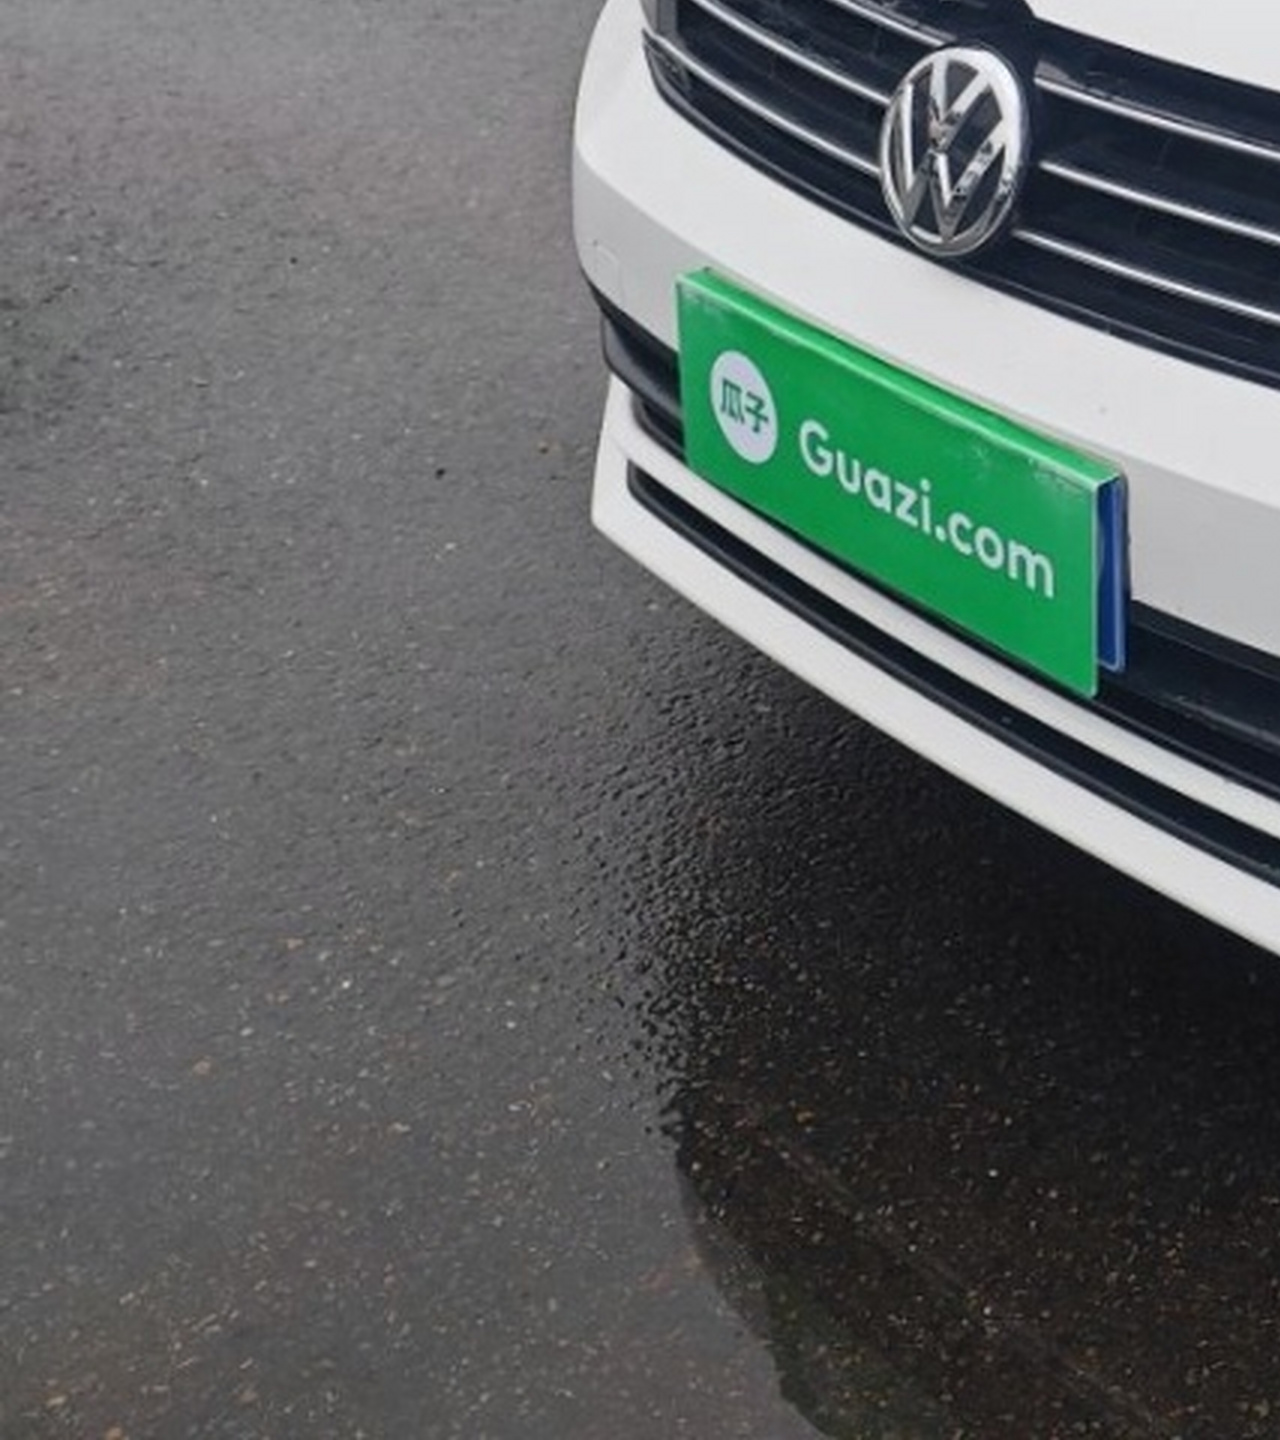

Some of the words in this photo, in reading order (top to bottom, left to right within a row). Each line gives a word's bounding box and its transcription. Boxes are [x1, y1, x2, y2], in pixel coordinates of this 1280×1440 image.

[883, 45, 1024, 255] VW
[720, 378, 769, 433] 瓜子
[799, 419, 1054, 599] Guazi.com
